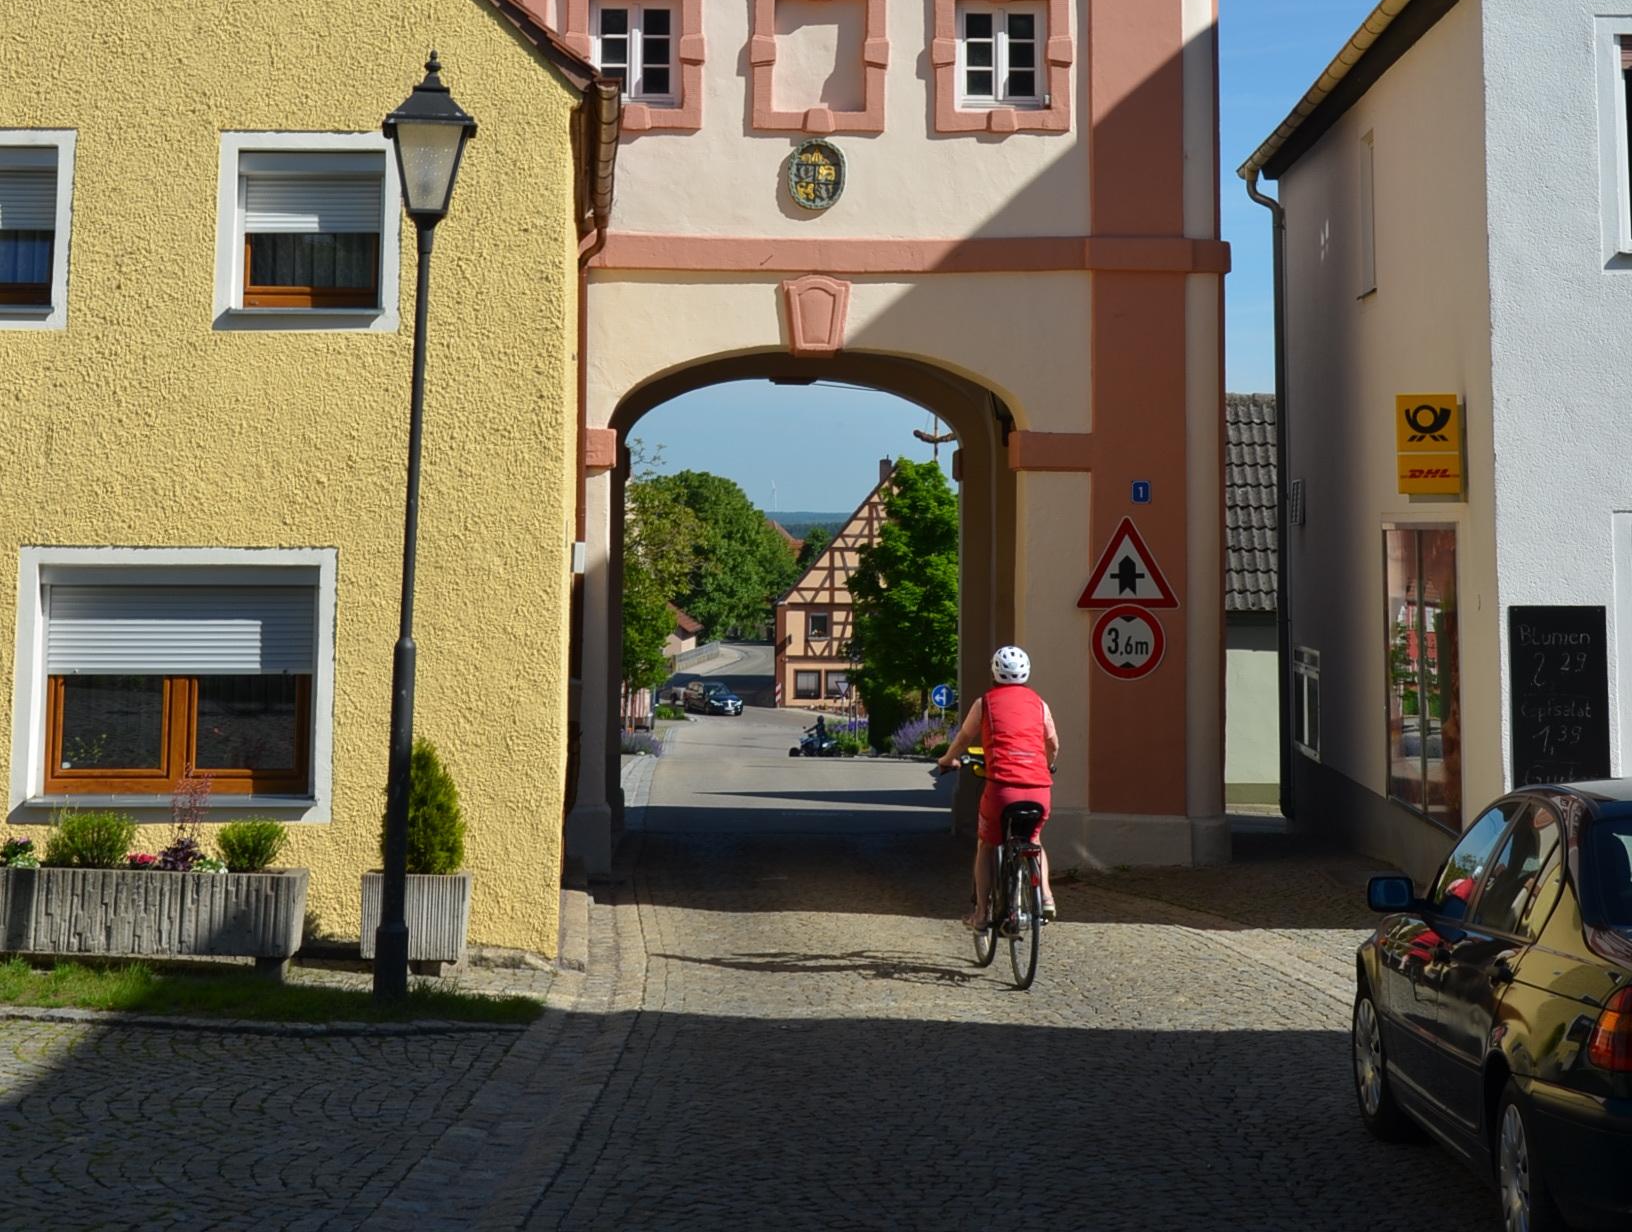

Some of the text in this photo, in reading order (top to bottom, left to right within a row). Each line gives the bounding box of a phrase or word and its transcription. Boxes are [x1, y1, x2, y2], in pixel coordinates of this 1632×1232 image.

[1408, 469, 1451, 479] DHL
[1138, 486, 1144, 498] 1
[1107, 627, 1149, 657] 3,6m
